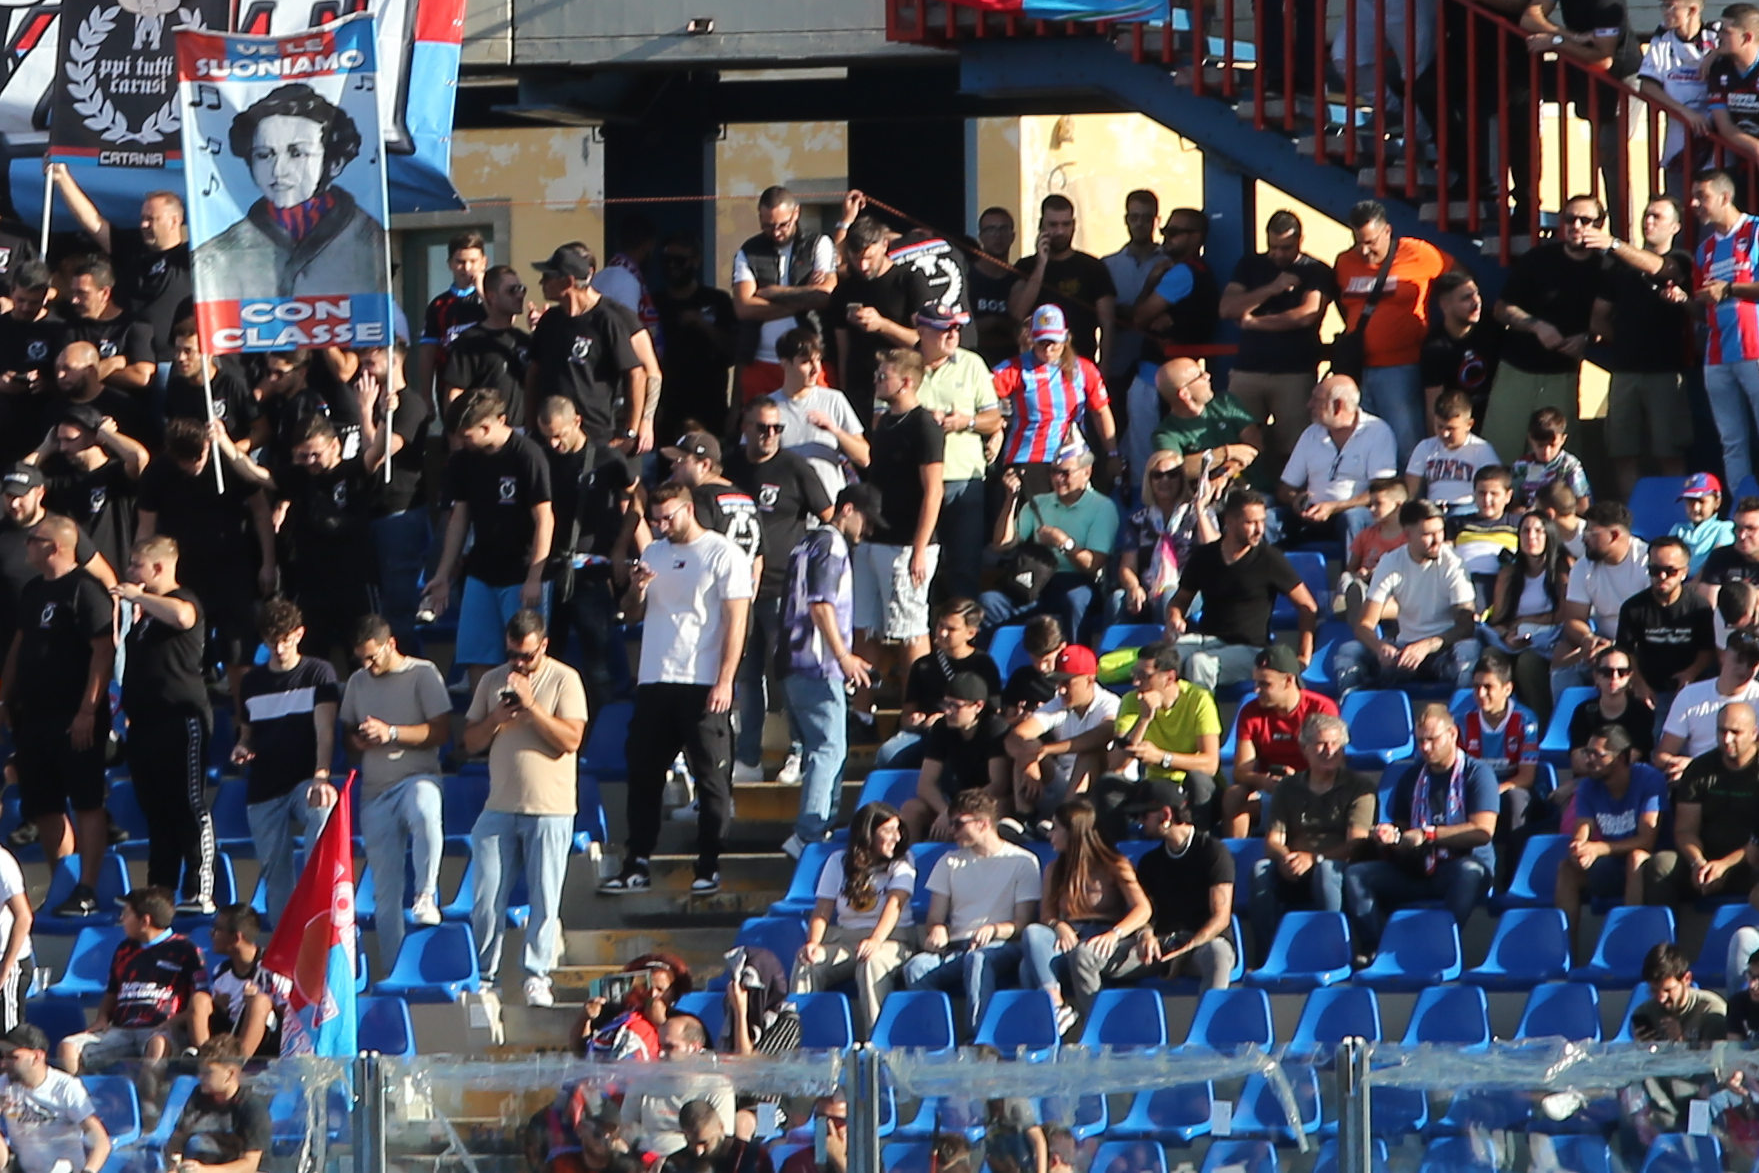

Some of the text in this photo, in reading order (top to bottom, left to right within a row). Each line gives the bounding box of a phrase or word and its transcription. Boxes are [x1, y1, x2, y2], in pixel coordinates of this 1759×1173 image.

[236, 38, 324, 56] VE LE
[98, 55, 174, 79] ppi tutti
[195, 49, 366, 77] SUONIAMO
[109, 77, 167, 95] carusi
[99, 151, 165, 165] CATANIA
[240, 299, 352, 324] CON
[211, 322, 385, 349] CLASSE
